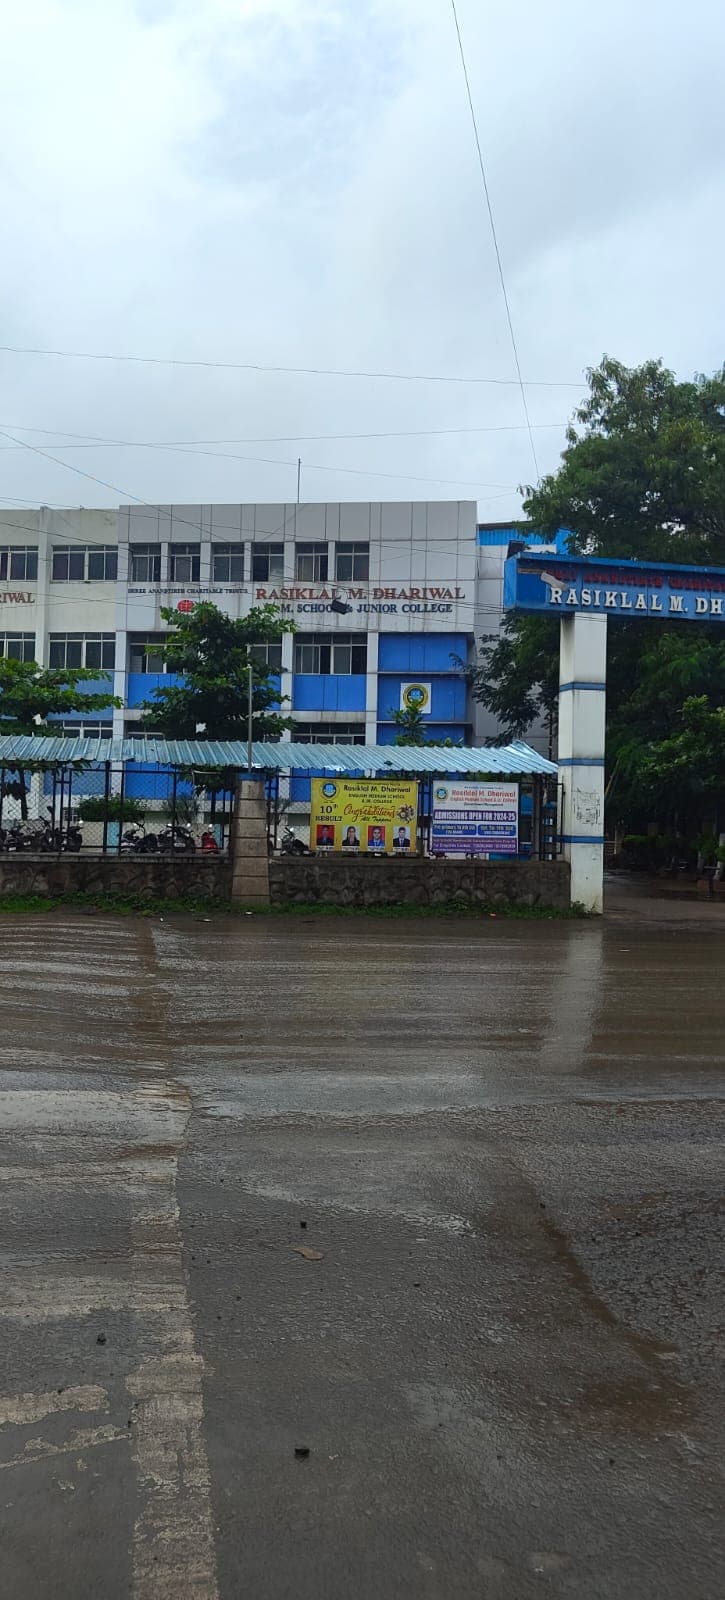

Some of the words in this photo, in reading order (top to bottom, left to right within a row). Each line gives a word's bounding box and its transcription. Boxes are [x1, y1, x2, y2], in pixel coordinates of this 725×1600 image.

[256, 588, 341, 599] RASIKLAL
[348, 588, 367, 599] M.
[372, 588, 465, 600] DHARIWAL
[550, 588, 662, 611] RASIKLAL
[669, 595, 689, 612] M.
[297, 603, 334, 613] SCHOO
[357, 604, 398, 614] JUNIOR
[402, 603, 452, 613] COLLEGE
[381, 785, 411, 793] Dhariwal
[434, 811, 468, 820] ADMISSIONS
[469, 812, 482, 820] OPEN
[483, 812, 493, 820] FOR
[494, 812, 516, 821] 2024-25
